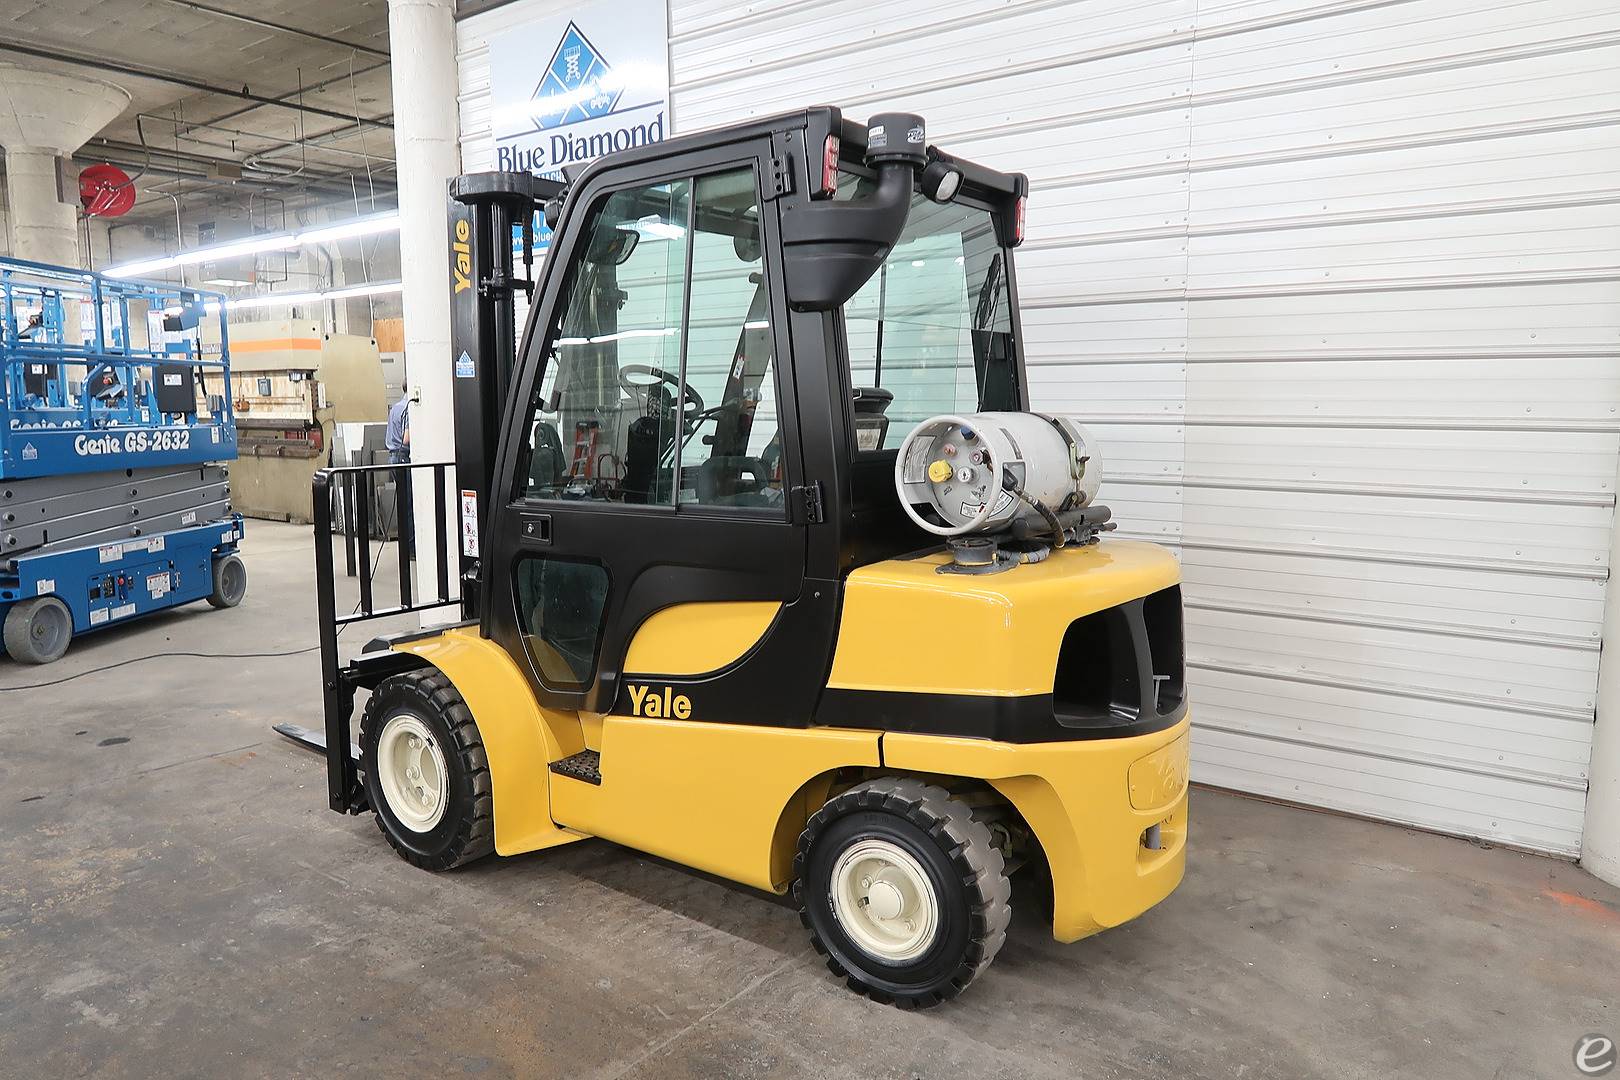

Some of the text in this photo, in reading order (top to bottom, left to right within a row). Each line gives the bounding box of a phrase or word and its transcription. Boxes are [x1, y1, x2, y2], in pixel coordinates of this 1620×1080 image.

[497, 111, 664, 172] Blue Diamond
[453, 219, 470, 294] Yale
[74, 430, 190, 456] Genie GS-2632
[627, 685, 691, 720] Yale
